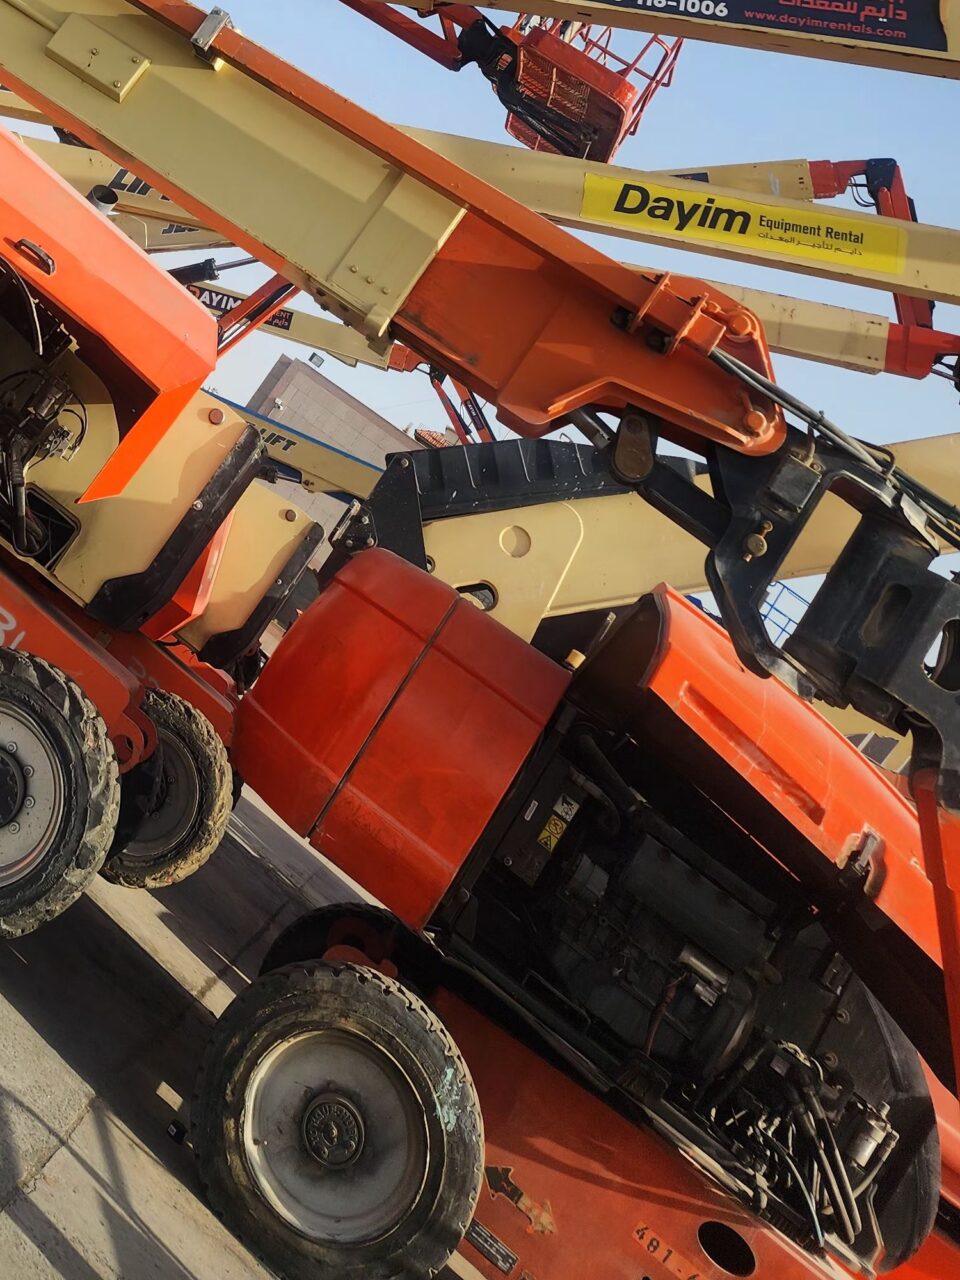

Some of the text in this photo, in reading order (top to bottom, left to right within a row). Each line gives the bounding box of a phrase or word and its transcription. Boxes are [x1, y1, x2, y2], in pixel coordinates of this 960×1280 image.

[744, 9, 907, 39] www.dayimrentals.com
[613, 183, 865, 245] Dayim Equipment Rental
